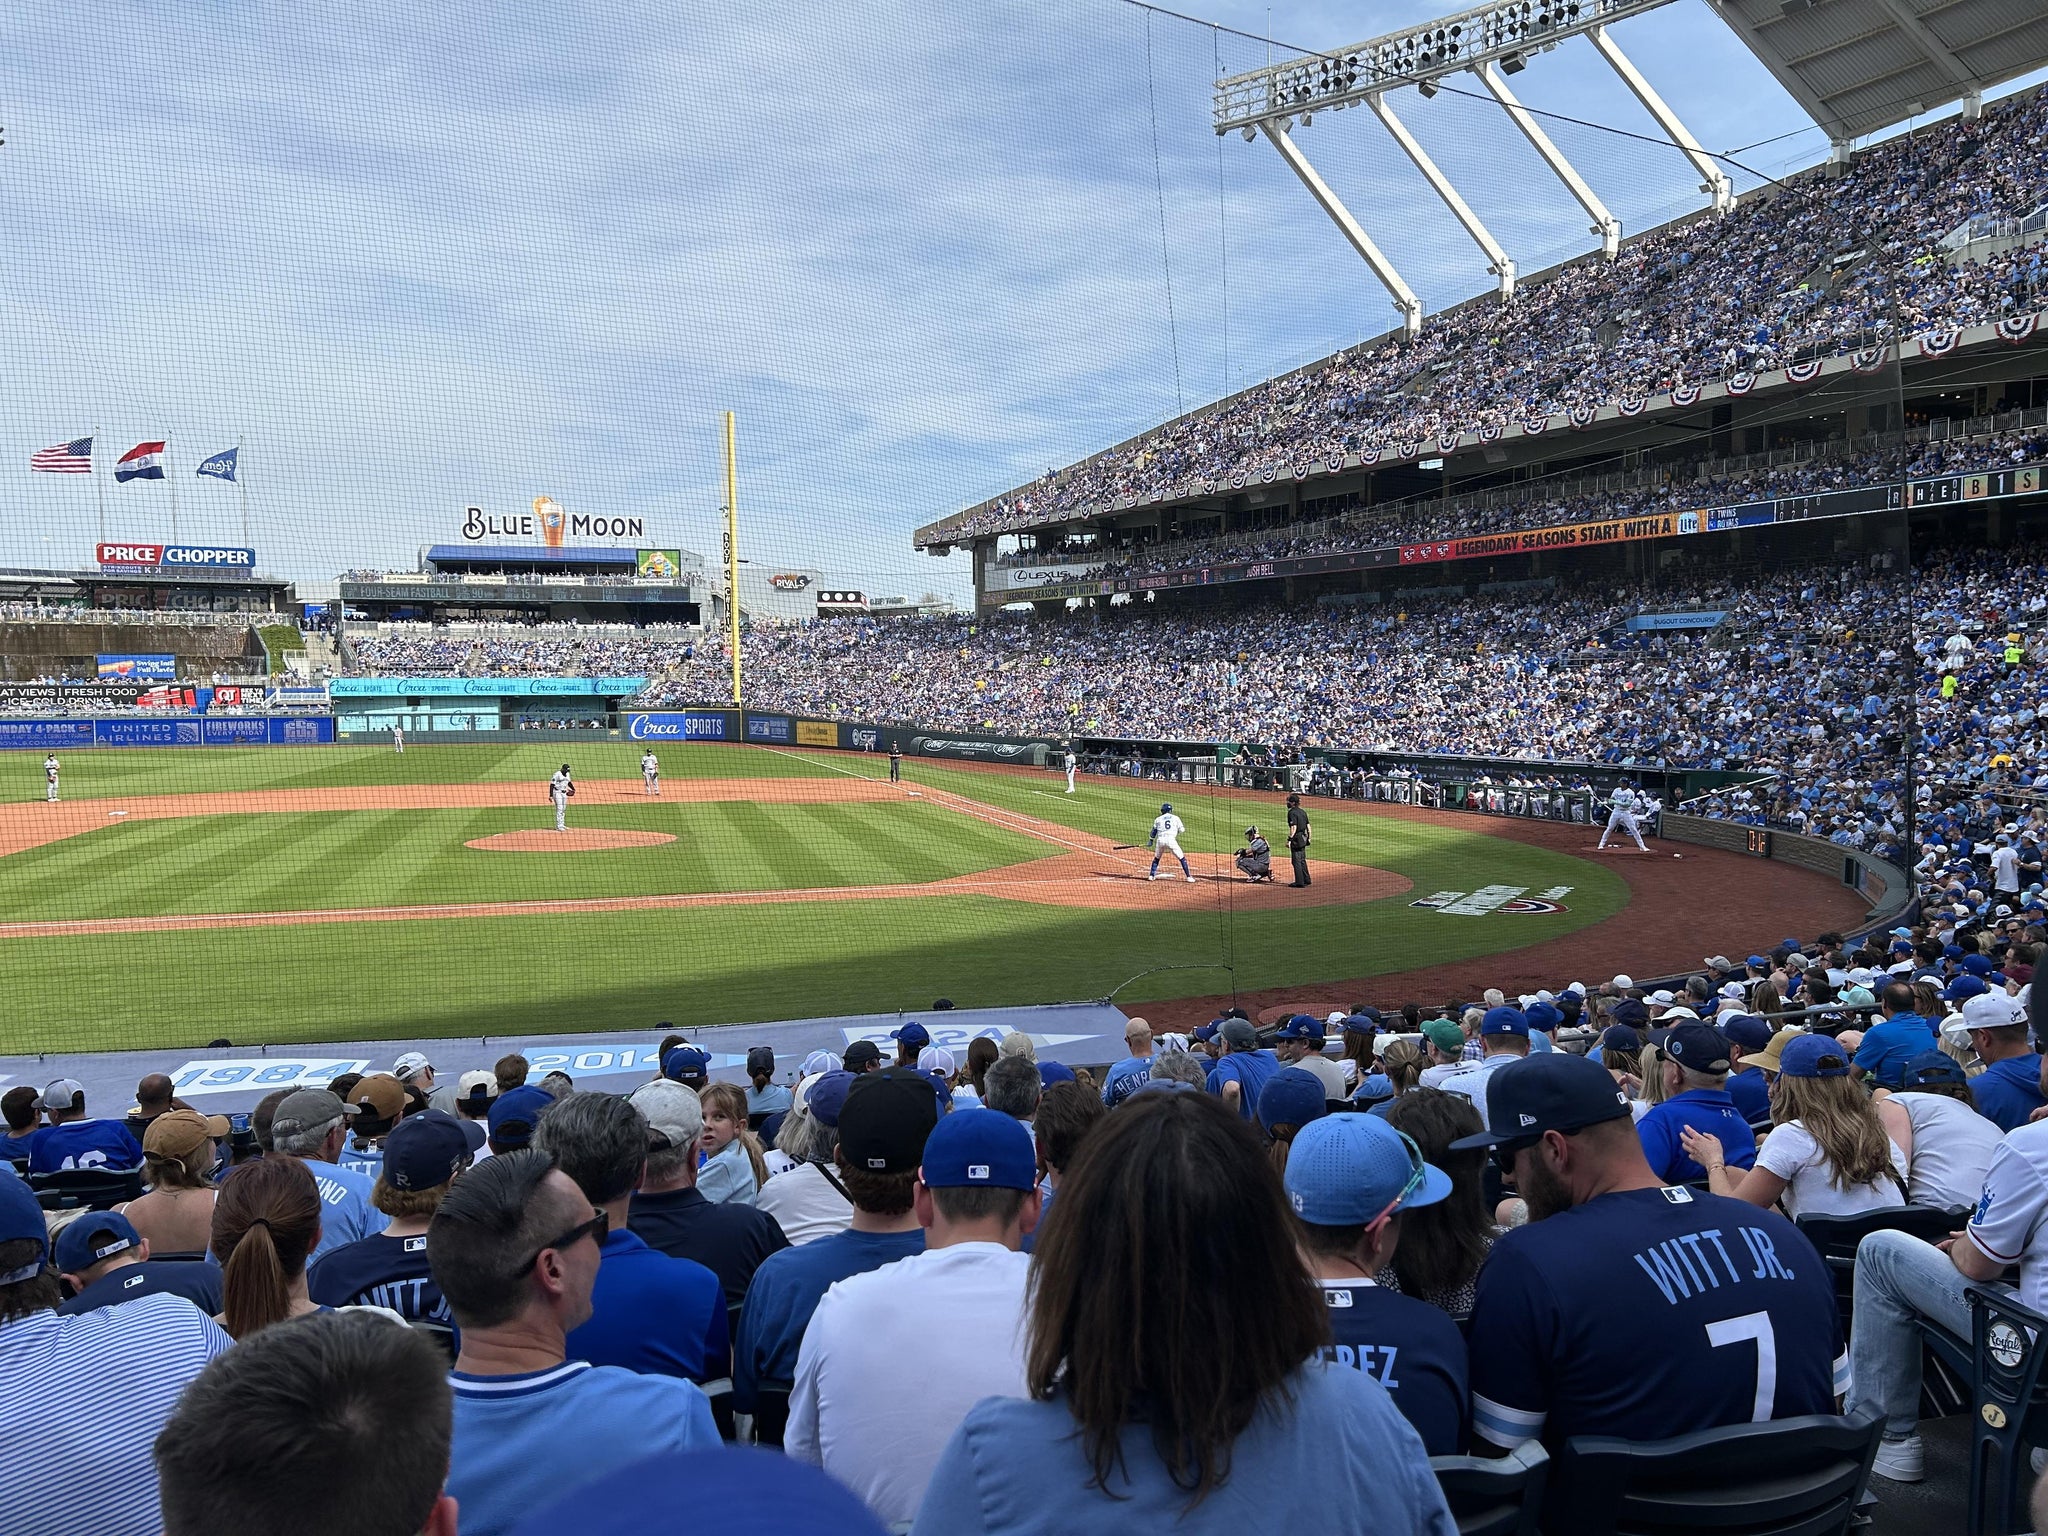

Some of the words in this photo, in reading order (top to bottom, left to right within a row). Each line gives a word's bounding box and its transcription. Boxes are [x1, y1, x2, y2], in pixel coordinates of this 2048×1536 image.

[1972, 480, 1979, 495] B
[1998, 474, 2004, 493] 1
[2024, 472, 2031, 488] S
[1917, 489, 1923, 500] H
[1942, 486, 1947, 498] E
[1717, 508, 1736, 518] TWINS
[462, 508, 532, 540] BLUE
[572, 514, 643, 536] MOON
[1717, 518, 1739, 528] ROYALS
[1456, 536, 1518, 556] LEGENDARY
[1522, 530, 1576, 548] SEASONS
[1580, 524, 1618, 543] START
[1623, 520, 1659, 538] WITH
[1660, 518, 1671, 534] A
[1679, 515, 1697, 532] Lite
[104, 547, 155, 561] PRICE
[166, 549, 249, 564] CHOPPER
[1028, 570, 1068, 579] LEXUS
[1261, 564, 1274, 576] BELL
[777, 579, 804, 589] RIVALS
[361, 587, 408, 598] FOUR-SEAM
[411, 587, 450, 598] FASTBALL
[472, 588, 482, 598] 90
[521, 589, 530, 599] 15
[571, 590, 577, 599] 2
[1006, 590, 1033, 601] LEGENDARY
[1035, 588, 1058, 598] SEASONS
[1060, 586, 1077, 597] START
[1078, 585, 1092, 596] WITH
[1093, 584, 1099, 594] A
[102, 594, 148, 608] PRIC
[18, 688, 55, 696] VIEWS
[65, 688, 103, 696] FRESH
[106, 688, 137, 696] FOOD
[330, 680, 359, 694] Circa
[397, 680, 426, 694] Circa
[464, 680, 493, 694] Circa
[530, 680, 558, 694] Circa
[594, 680, 621, 694] Circa
[218, 690, 236, 700] QT
[35, 724, 76, 733] 4-PACK
[206, 721, 264, 731] FIREWORKS
[630, 714, 680, 739] Circa
[686, 719, 723, 735] SPORTS
[1164, 821, 1171, 829] 6
[860, 1028, 1005, 1047] 224
[172, 1062, 357, 1088] 1984
[1634, 1229, 1740, 1305] WITT
[1738, 1226, 1794, 1281] JR.
[1705, 1311, 1776, 1422] 7
[1988, 1410, 1999, 1422] J
